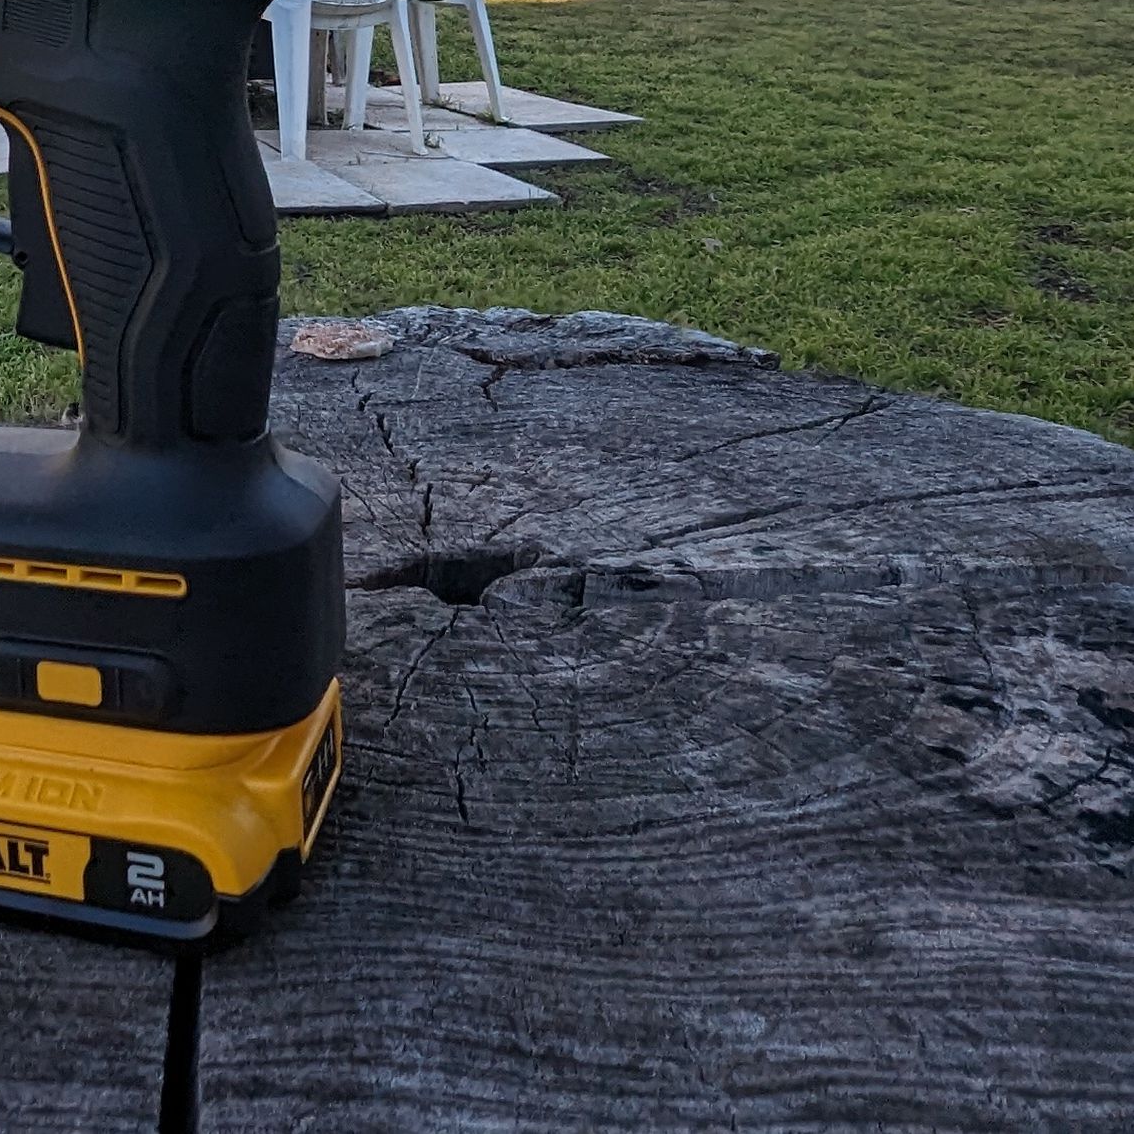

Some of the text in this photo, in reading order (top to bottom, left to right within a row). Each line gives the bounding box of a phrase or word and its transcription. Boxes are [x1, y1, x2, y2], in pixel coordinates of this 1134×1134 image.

[24, 775, 107, 811] ION
[126, 851, 165, 890] 2
[130, 888, 165, 908] AH
